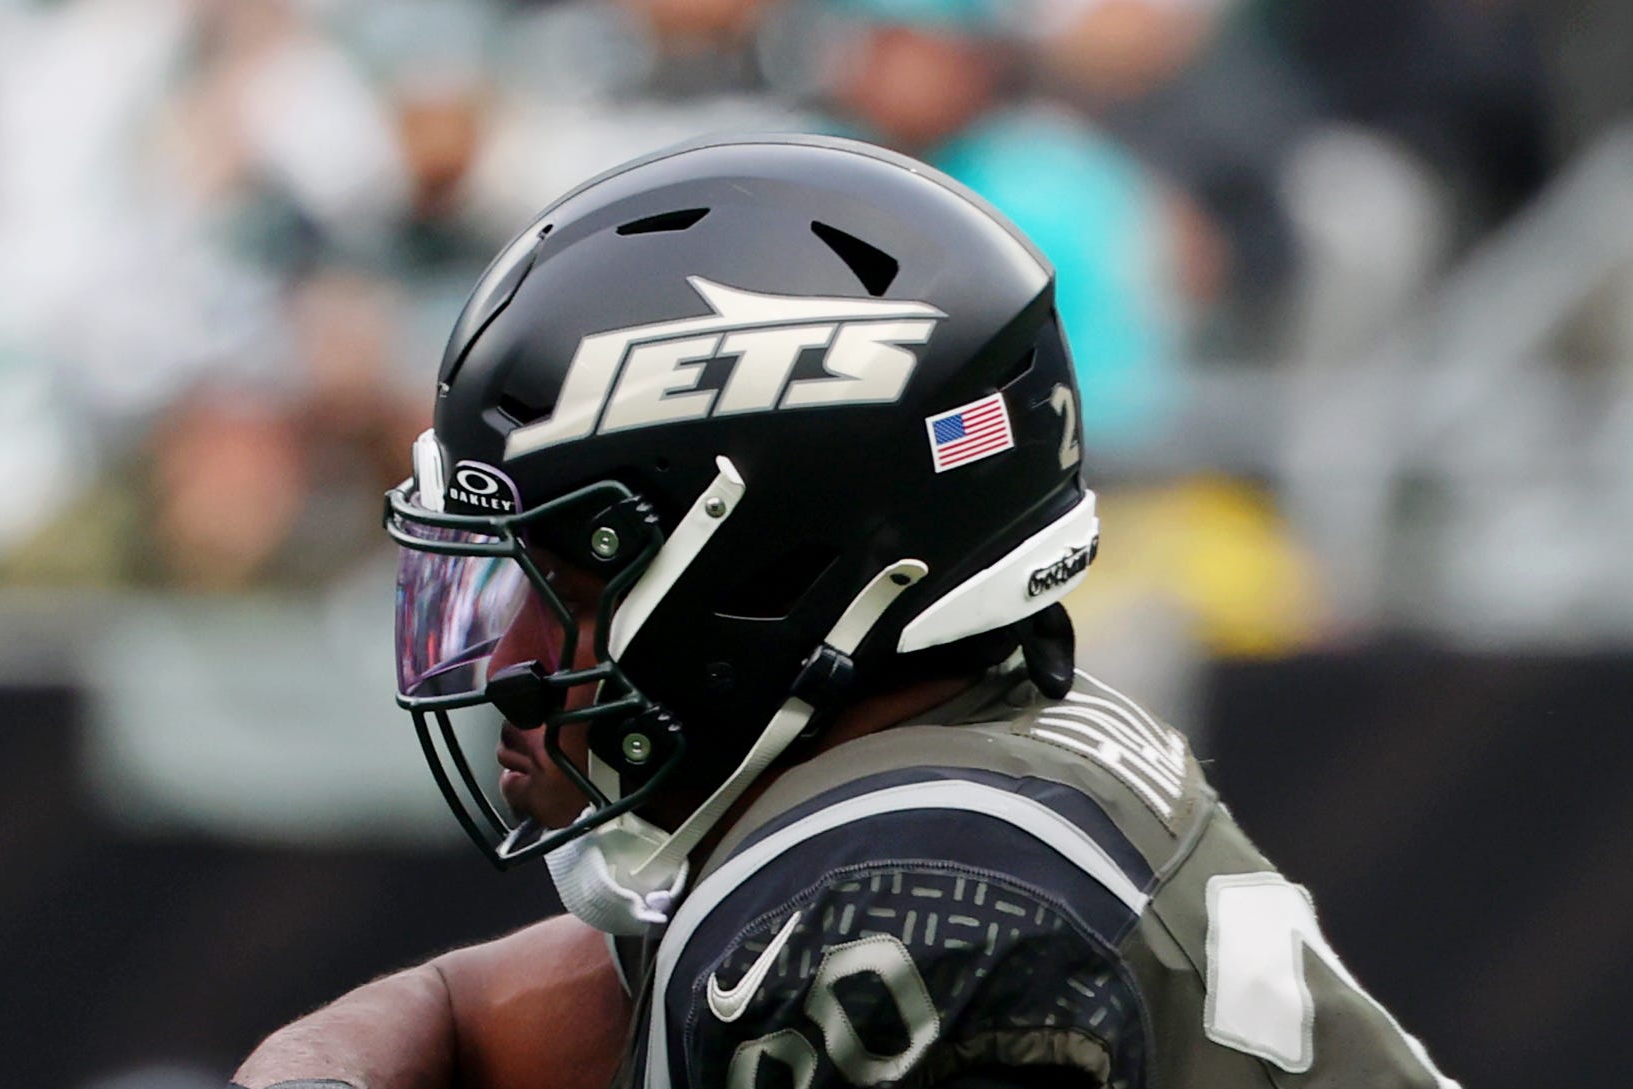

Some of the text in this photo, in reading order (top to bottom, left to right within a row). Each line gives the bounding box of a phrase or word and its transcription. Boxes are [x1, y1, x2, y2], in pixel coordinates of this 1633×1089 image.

[503, 274, 949, 462] JETS
[1049, 382, 1080, 470] 2
[449, 486, 514, 511] OAKLEY
